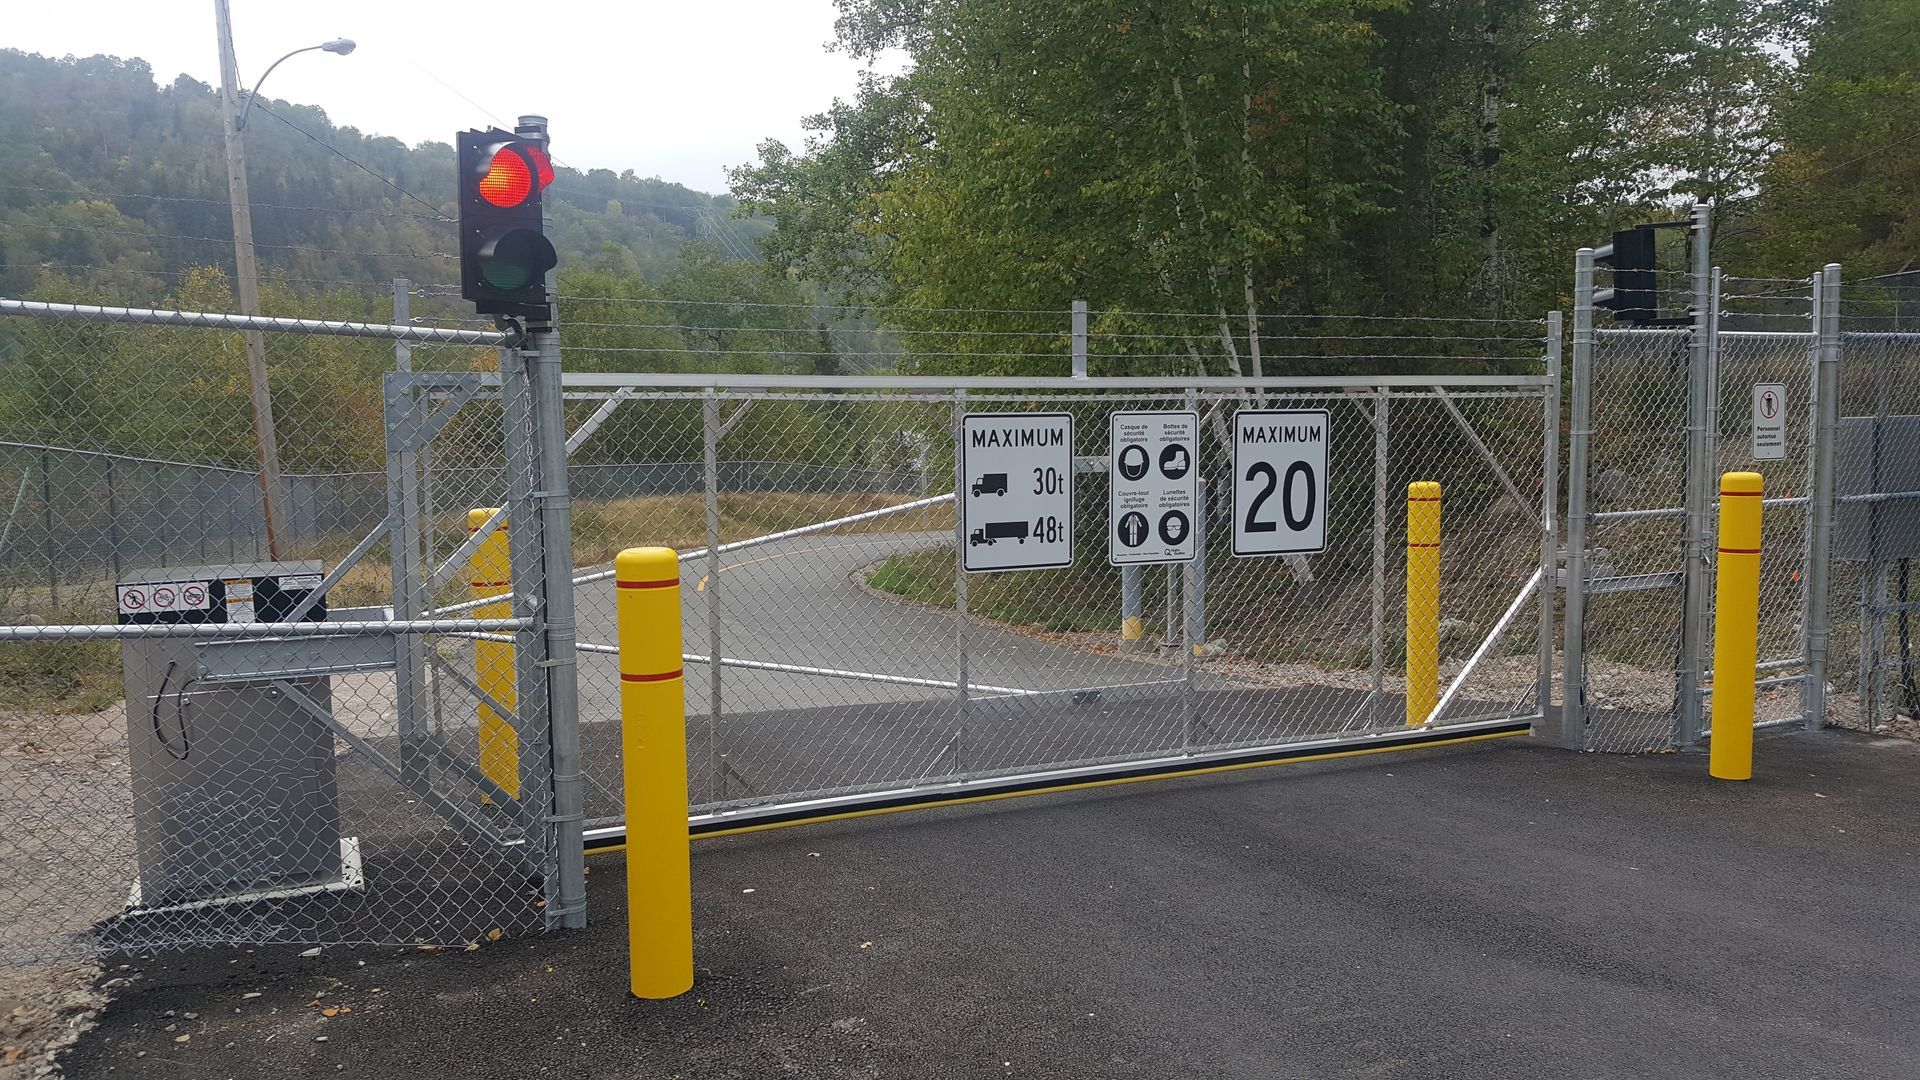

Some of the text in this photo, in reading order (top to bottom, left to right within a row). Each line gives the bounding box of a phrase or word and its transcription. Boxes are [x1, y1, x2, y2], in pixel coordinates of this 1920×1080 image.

[972, 428, 1064, 448] MAXIMUM
[1242, 425, 1321, 444] MAXIMUM
[1032, 466, 1064, 496] 30t
[1244, 460, 1316, 533] 20
[1032, 515, 1064, 544] 48t
